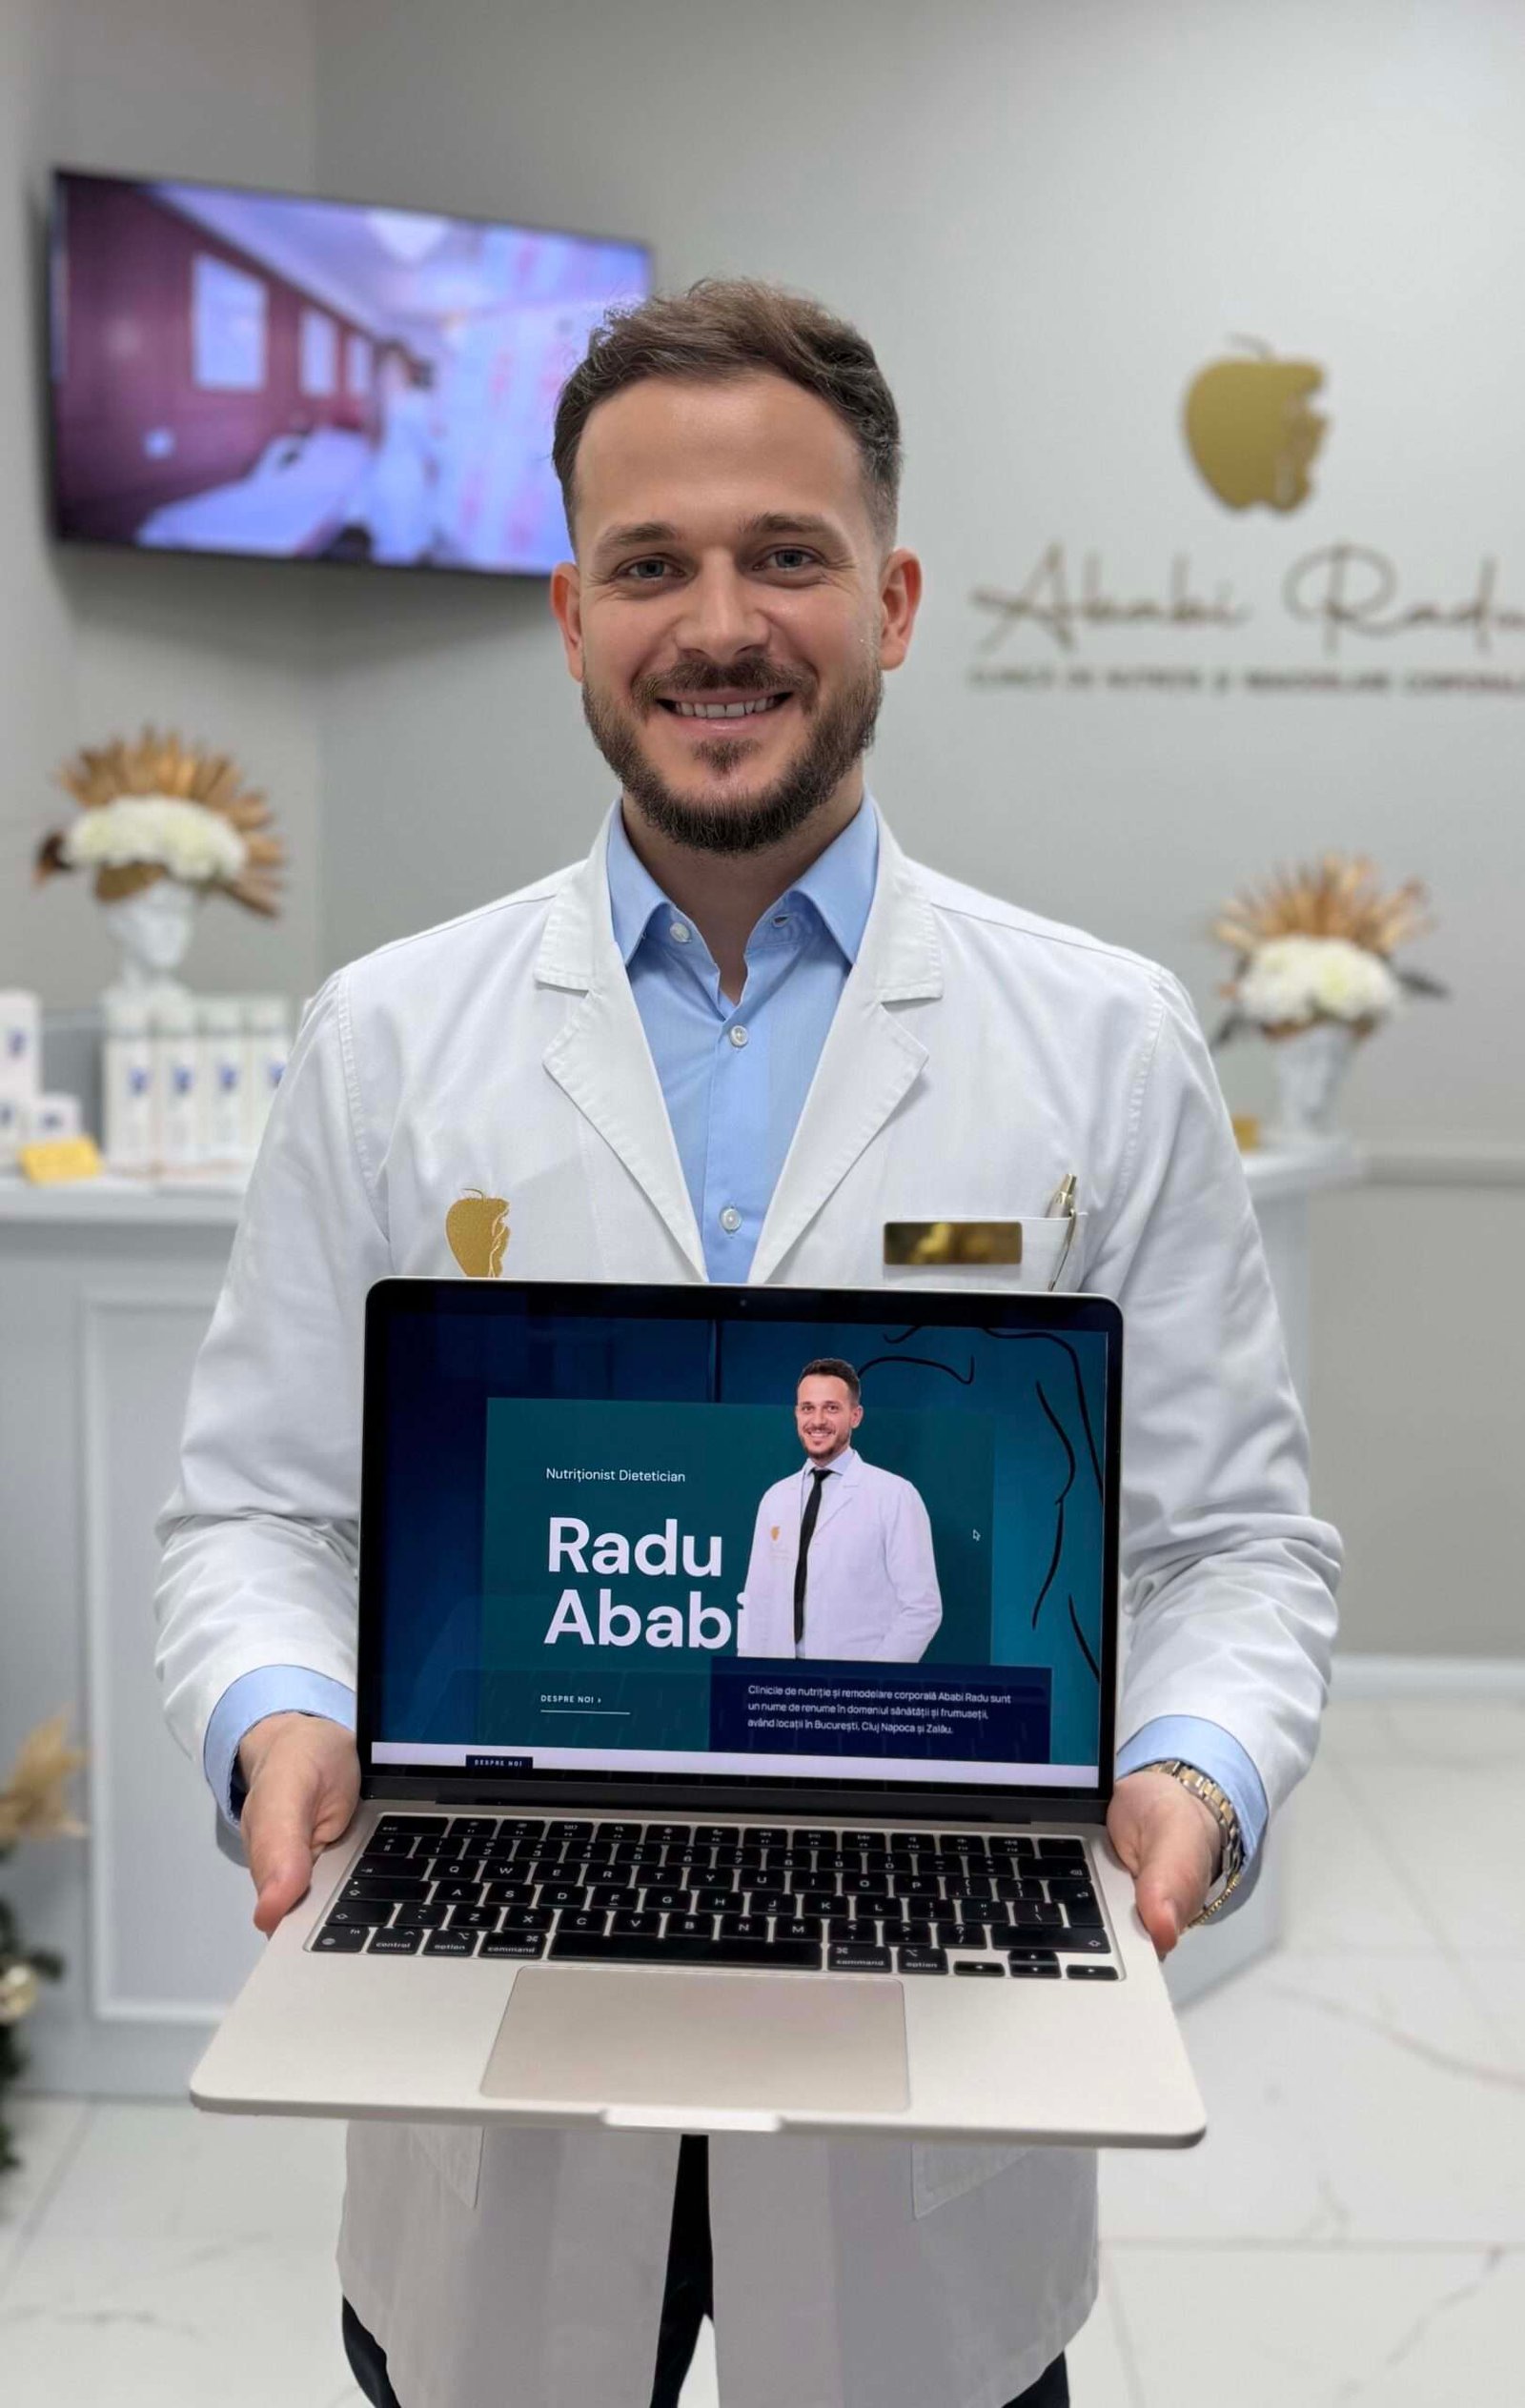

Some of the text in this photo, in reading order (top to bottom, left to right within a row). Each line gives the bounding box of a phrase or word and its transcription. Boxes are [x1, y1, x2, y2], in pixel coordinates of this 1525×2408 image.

[546, 1467, 686, 1483] Nutriționist Dietetician
[548, 1516, 722, 1577] Radu
[543, 1588, 750, 1650] Ababi
[540, 1694, 594, 1704] DESPRE NOI
[748, 1685, 783, 1695] Clinicile
[784, 1687, 797, 1695] de
[798, 1688, 831, 1699] nutriție
[842, 1689, 893, 1699] remodelare
[938, 1692, 965, 1702] Ababi
[966, 1693, 989, 1703] Radu
[990, 1694, 1012, 1704] sunt
[748, 1703, 761, 1711] un
[761, 1703, 787, 1712] nume
[788, 1703, 801, 1712] de
[802, 1705, 836, 1713] renume
[847, 1705, 889, 1716] domeniul
[862, 1721, 880, 1733] Cluj
[881, 1723, 916, 1734] Napoca
[859, 1879, 870, 1888] O
[911, 1881, 922, 1890] P
[504, 1890, 515, 1898] S
[557, 1892, 568, 1900] D
[610, 1893, 620, 1902] F
[661, 1895, 673, 1904] G
[874, 1903, 884, 1912] L
[469, 1912, 804, 1933] Z X C V B N M
